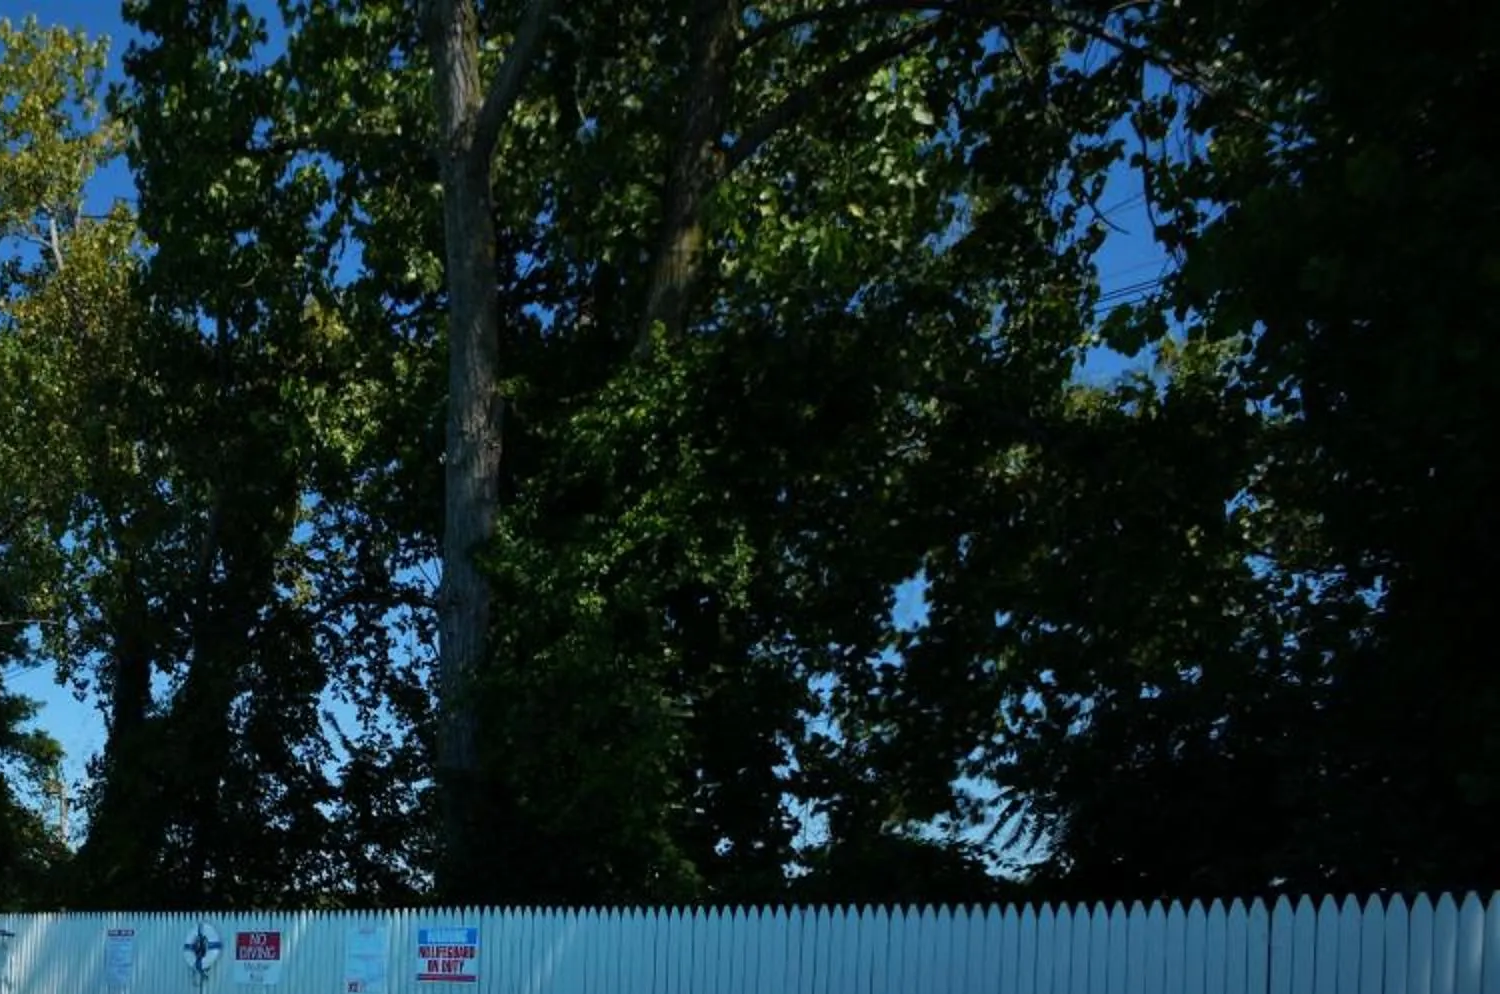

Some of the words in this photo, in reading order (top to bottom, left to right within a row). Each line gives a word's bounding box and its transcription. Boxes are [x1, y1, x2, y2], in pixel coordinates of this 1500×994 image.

[250, 934, 266, 945] NO
[240, 945, 276, 958] DIVING
[428, 959, 439, 973] ON
[441, 959, 465, 973] DUTY
